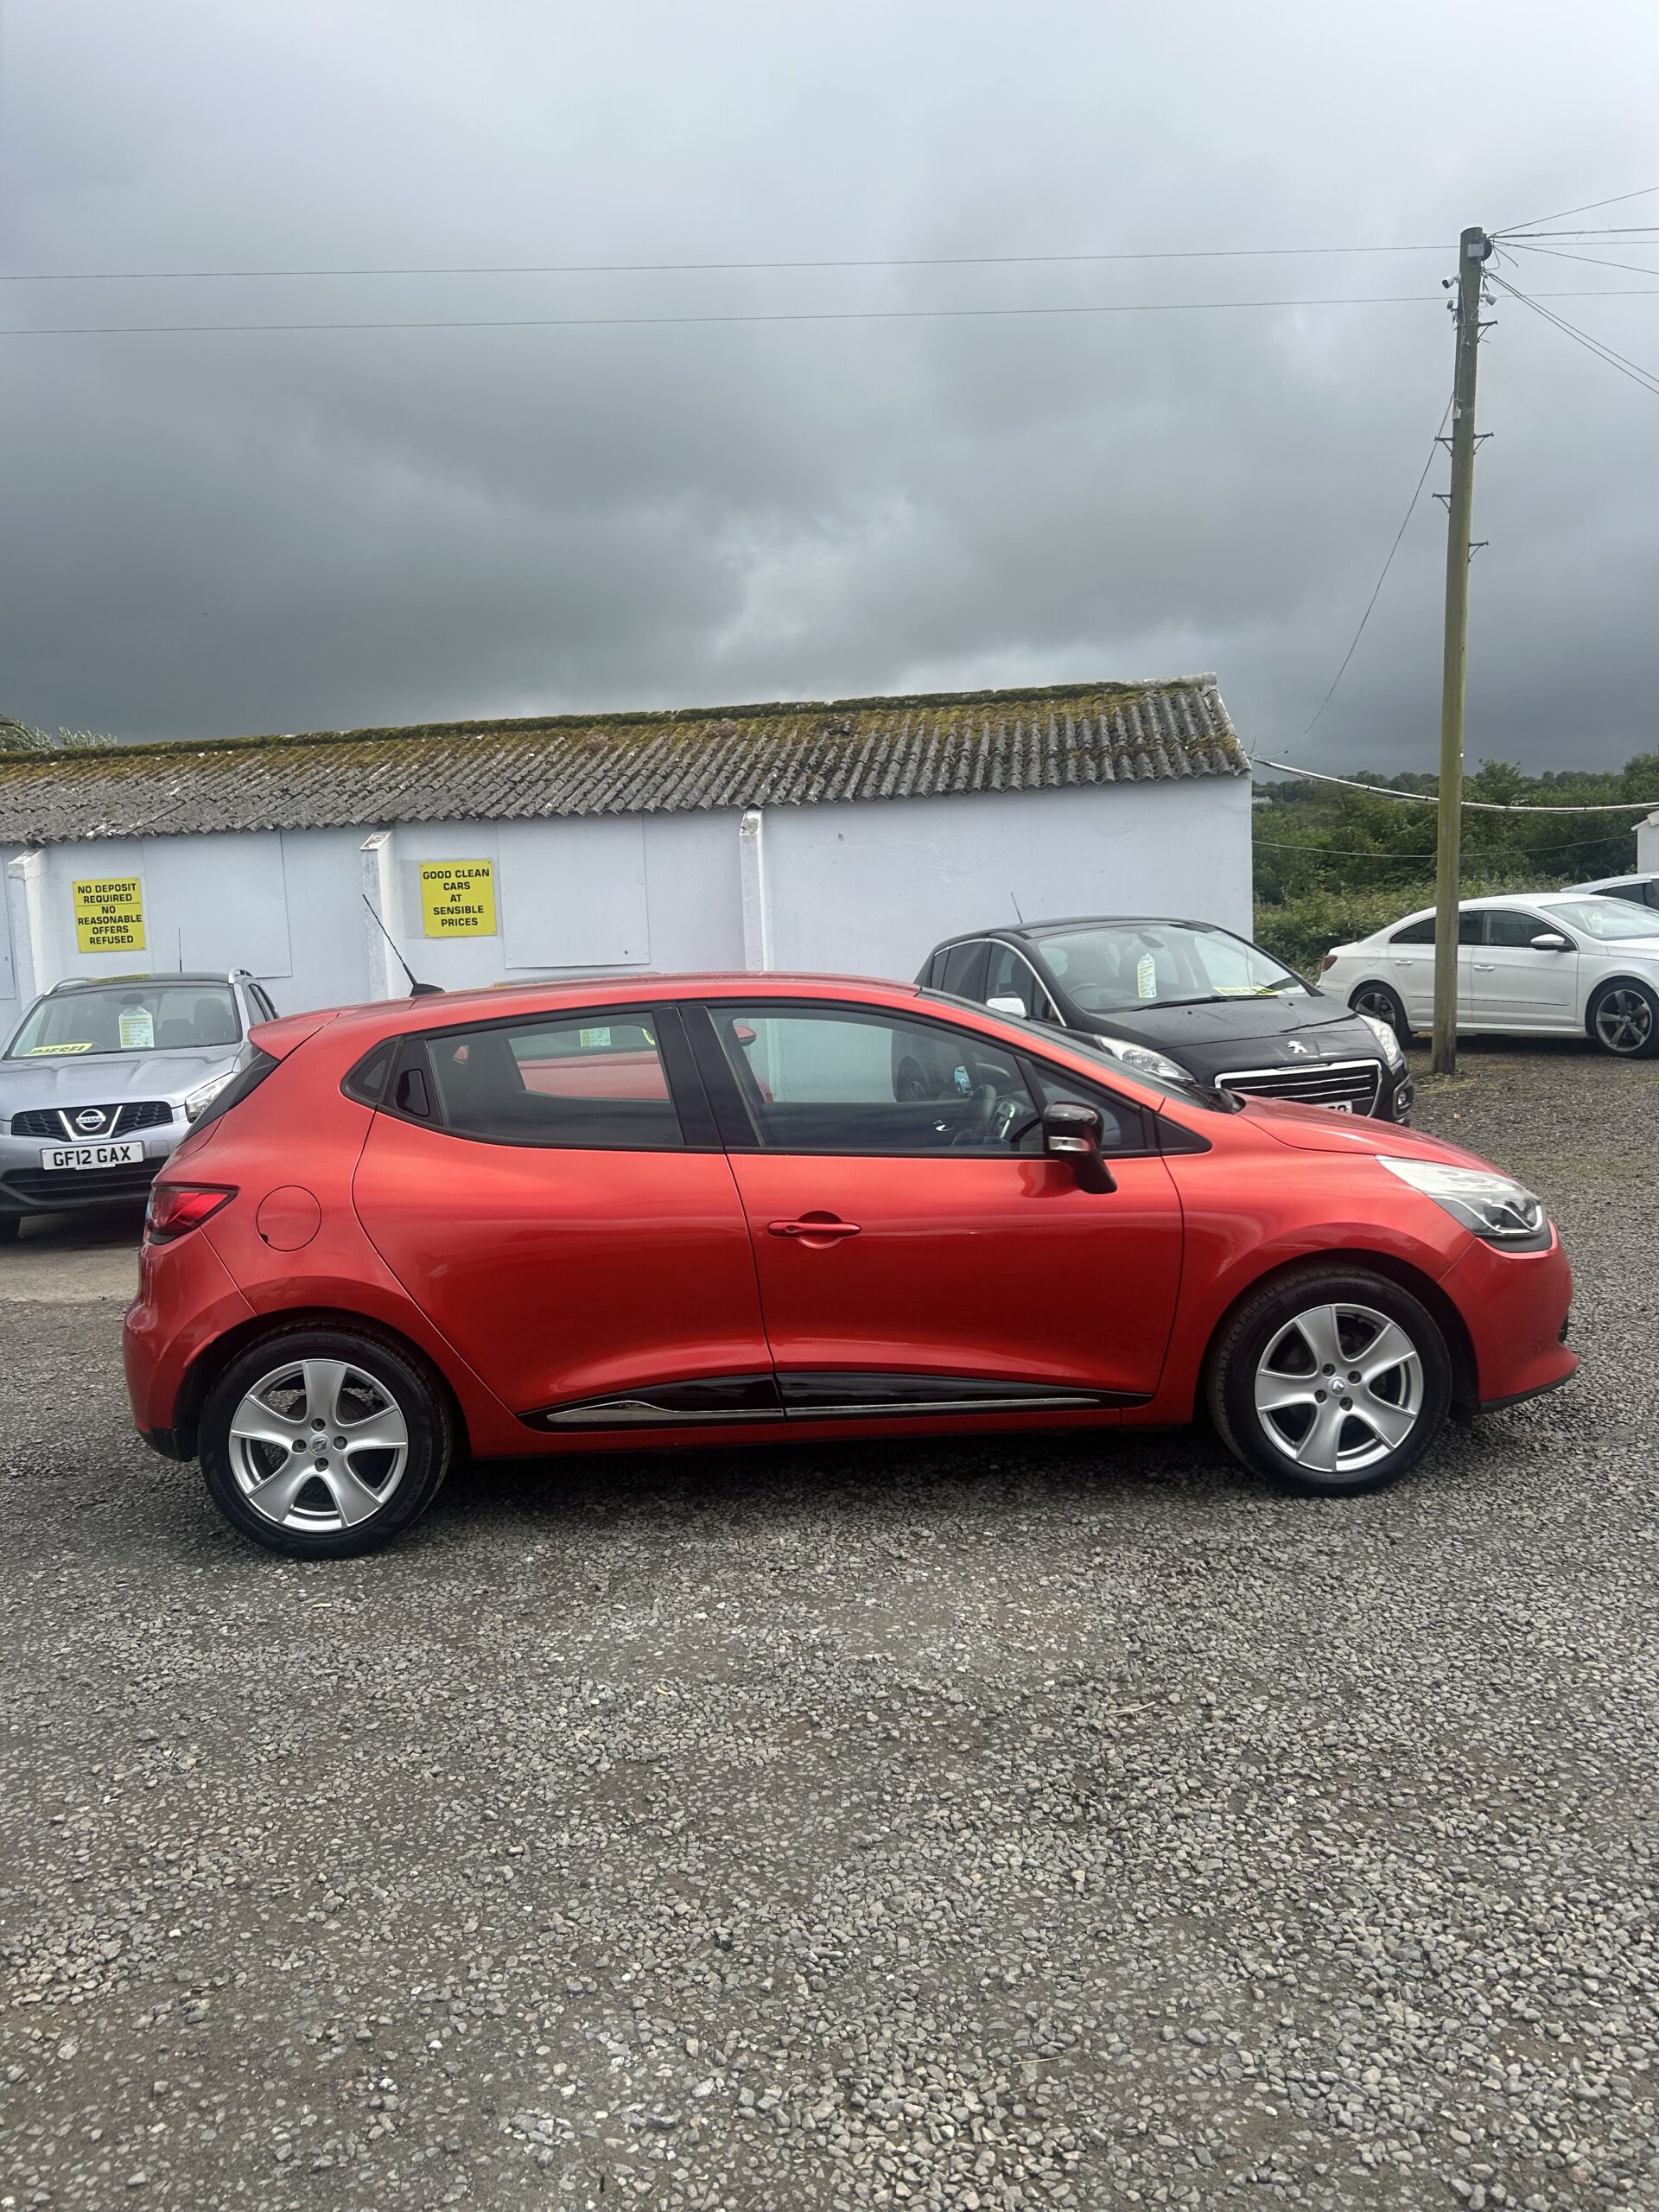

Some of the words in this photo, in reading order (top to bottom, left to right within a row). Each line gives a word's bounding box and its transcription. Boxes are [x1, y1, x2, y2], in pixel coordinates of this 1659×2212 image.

[423, 870, 452, 880] GOOD
[454, 868, 490, 879] CLEAN
[95, 883, 137, 893] DEPOSIT
[443, 881, 471, 891] CARS
[83, 893, 132, 904] REQUIRED
[101, 906, 116, 914] NO
[433, 905, 484, 915] SENSIBLE
[77, 914, 143, 925] REASONABLE
[441, 917, 478, 927] PRICES
[92, 925, 129, 935] OFFERS
[89, 935, 134, 945] REFUSED
[53, 1149, 92, 1166] GF12
[97, 1146, 131, 1163] GAX
